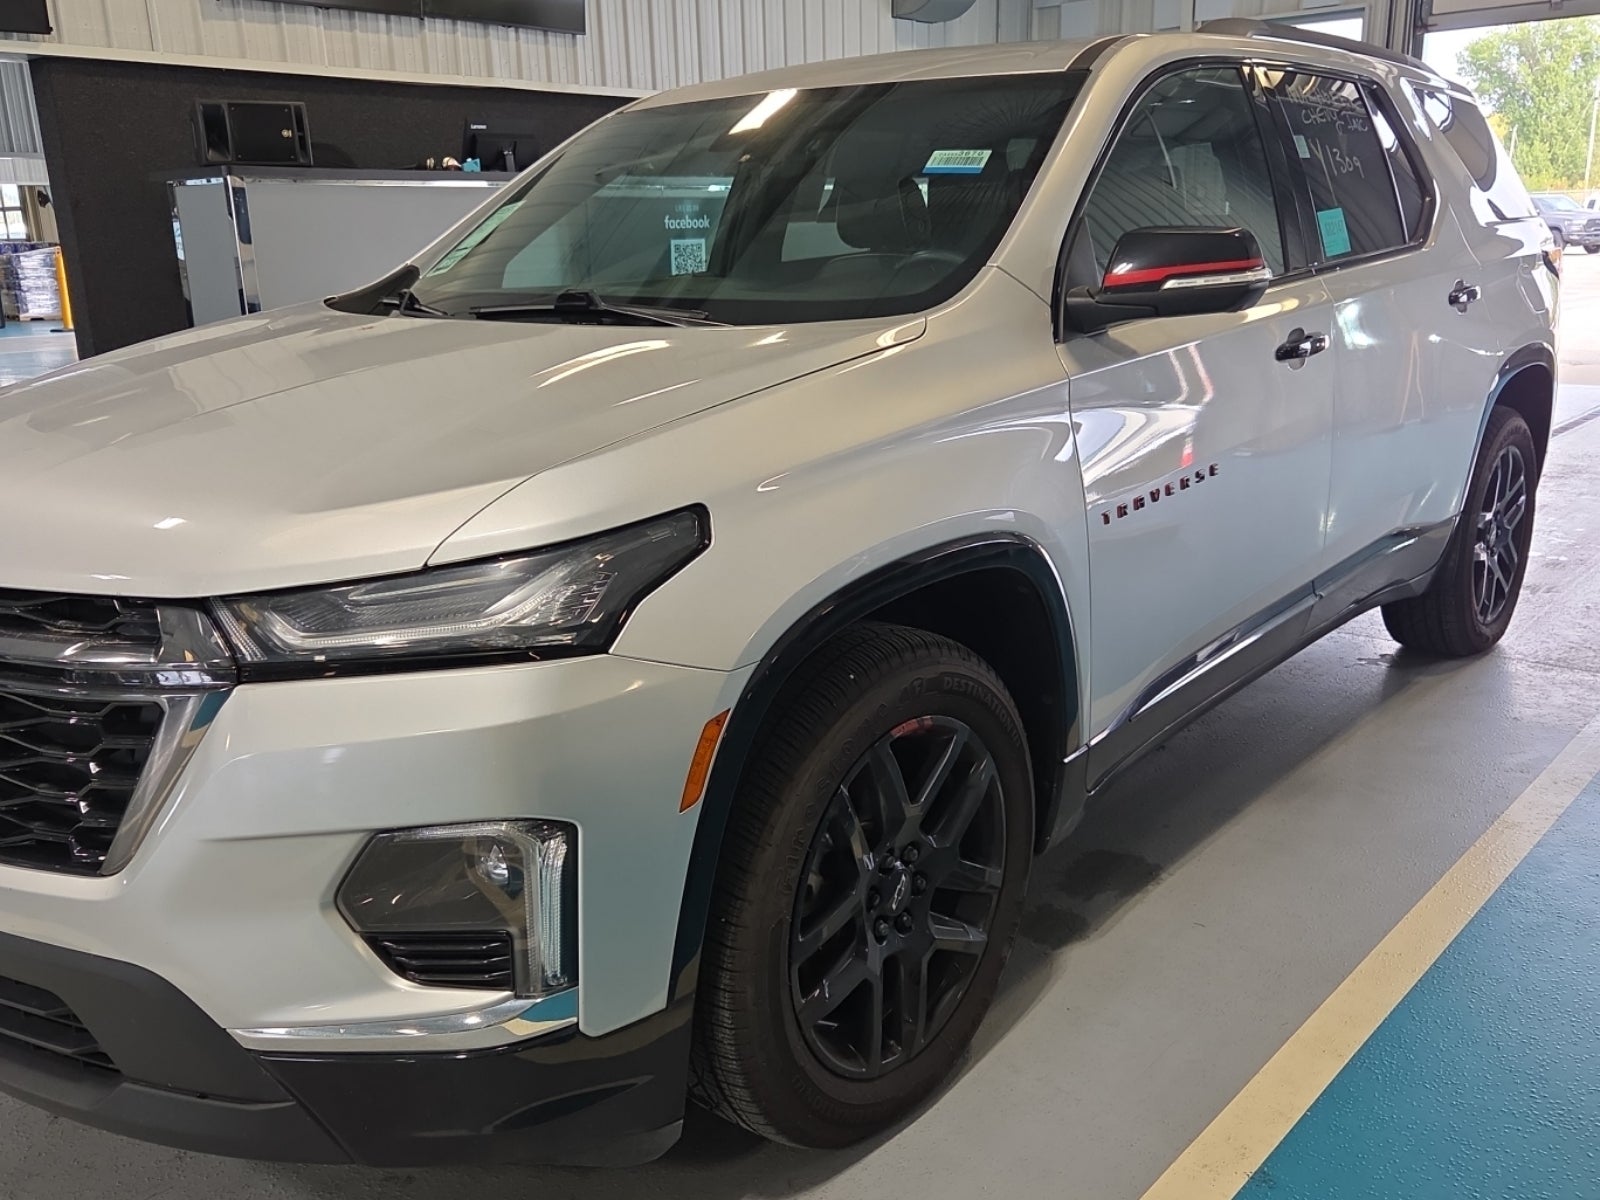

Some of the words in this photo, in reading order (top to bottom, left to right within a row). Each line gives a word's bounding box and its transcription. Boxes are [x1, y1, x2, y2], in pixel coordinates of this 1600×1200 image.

[664, 215, 710, 229] facebook
[1101, 463, 1219, 525] TRAVERSE
[943, 675, 1014, 732] DESTINATION
